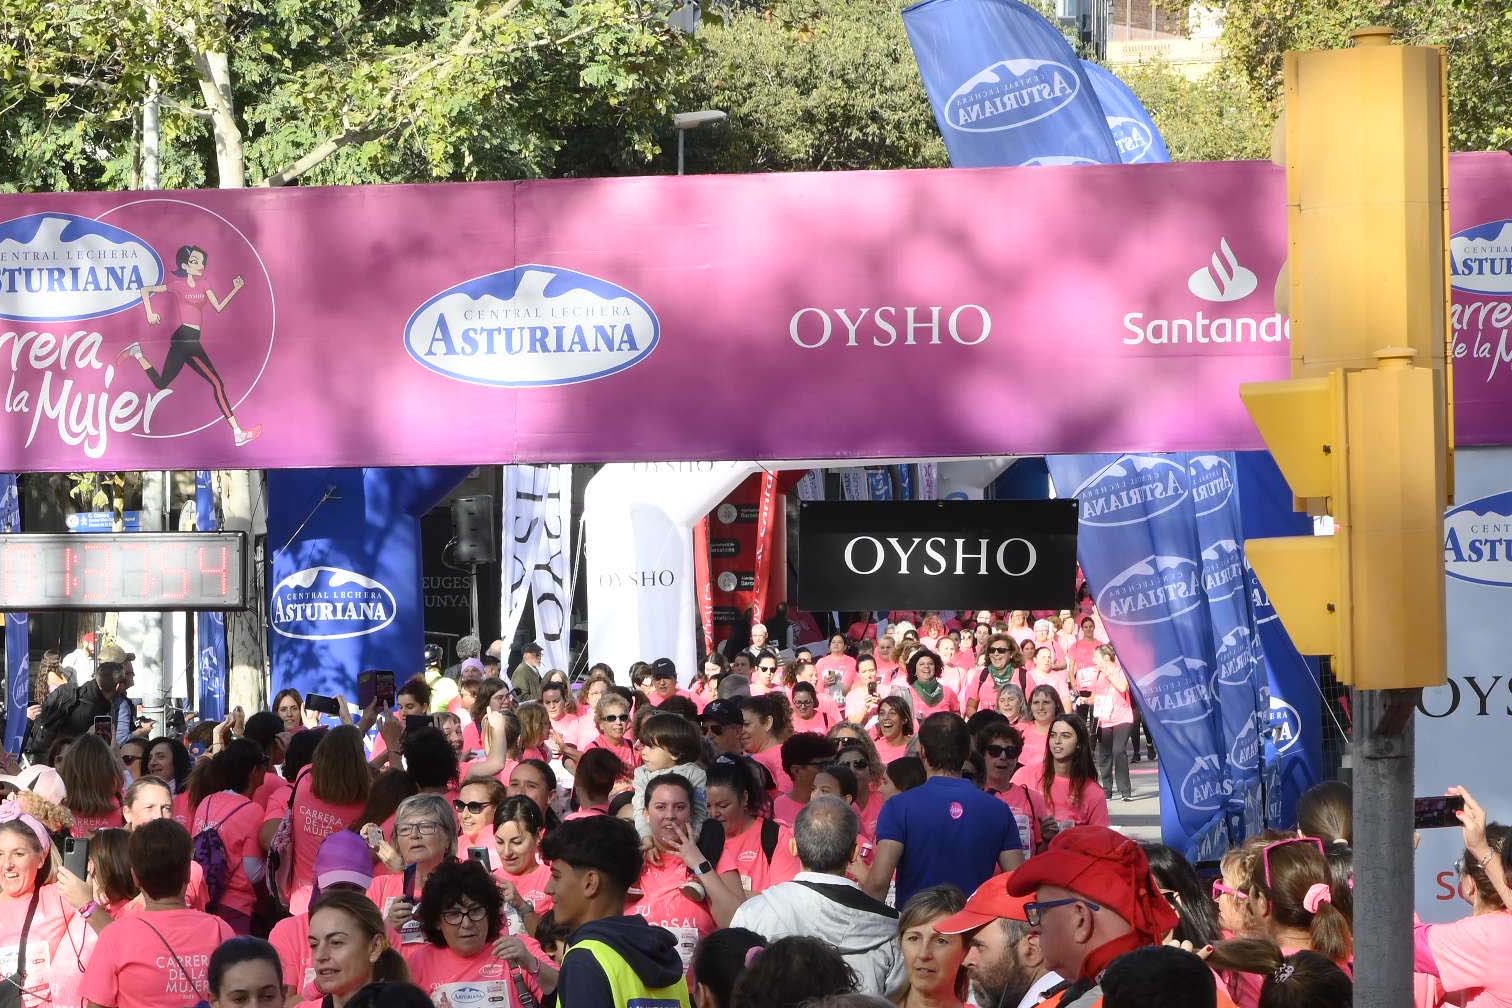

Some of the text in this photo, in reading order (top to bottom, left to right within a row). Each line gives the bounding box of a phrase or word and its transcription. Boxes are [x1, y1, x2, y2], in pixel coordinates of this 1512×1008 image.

[66, 248, 139, 260] LECHERA
[463, 307, 541, 321] CENTRAL
[789, 304, 993, 349] OYSHO
[424, 312, 640, 356] ASTURIANA
[1472, 332, 1491, 358] la
[4, 373, 30, 413] la
[24, 364, 174, 459] Mujer
[844, 536, 1037, 577] OYSHO
[287, 591, 382, 600] CENTRAL LECHERA
[275, 596, 387, 623] ASTURIANA
[299, 805, 343, 825] CARRERA
[156, 955, 209, 969] CARRER
